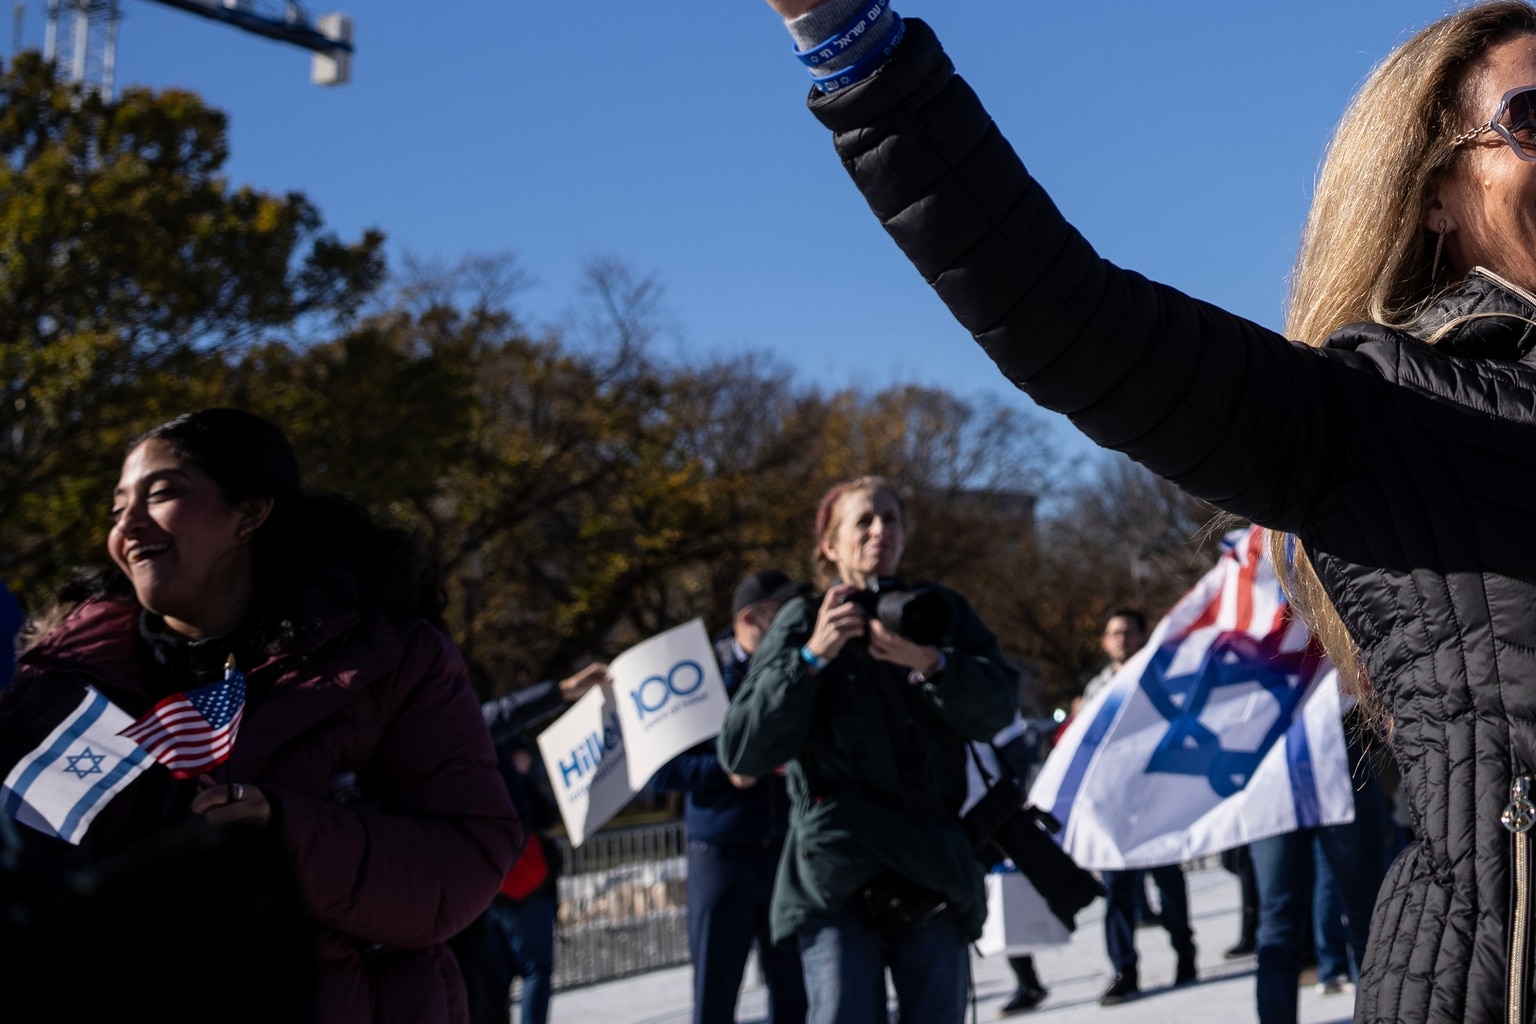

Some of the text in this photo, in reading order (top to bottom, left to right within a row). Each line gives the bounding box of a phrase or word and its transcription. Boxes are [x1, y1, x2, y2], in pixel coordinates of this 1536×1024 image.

[819, 4, 882, 59] עם ישראל חי
[629, 659, 706, 720] 100
[557, 712, 622, 789] Hillel
